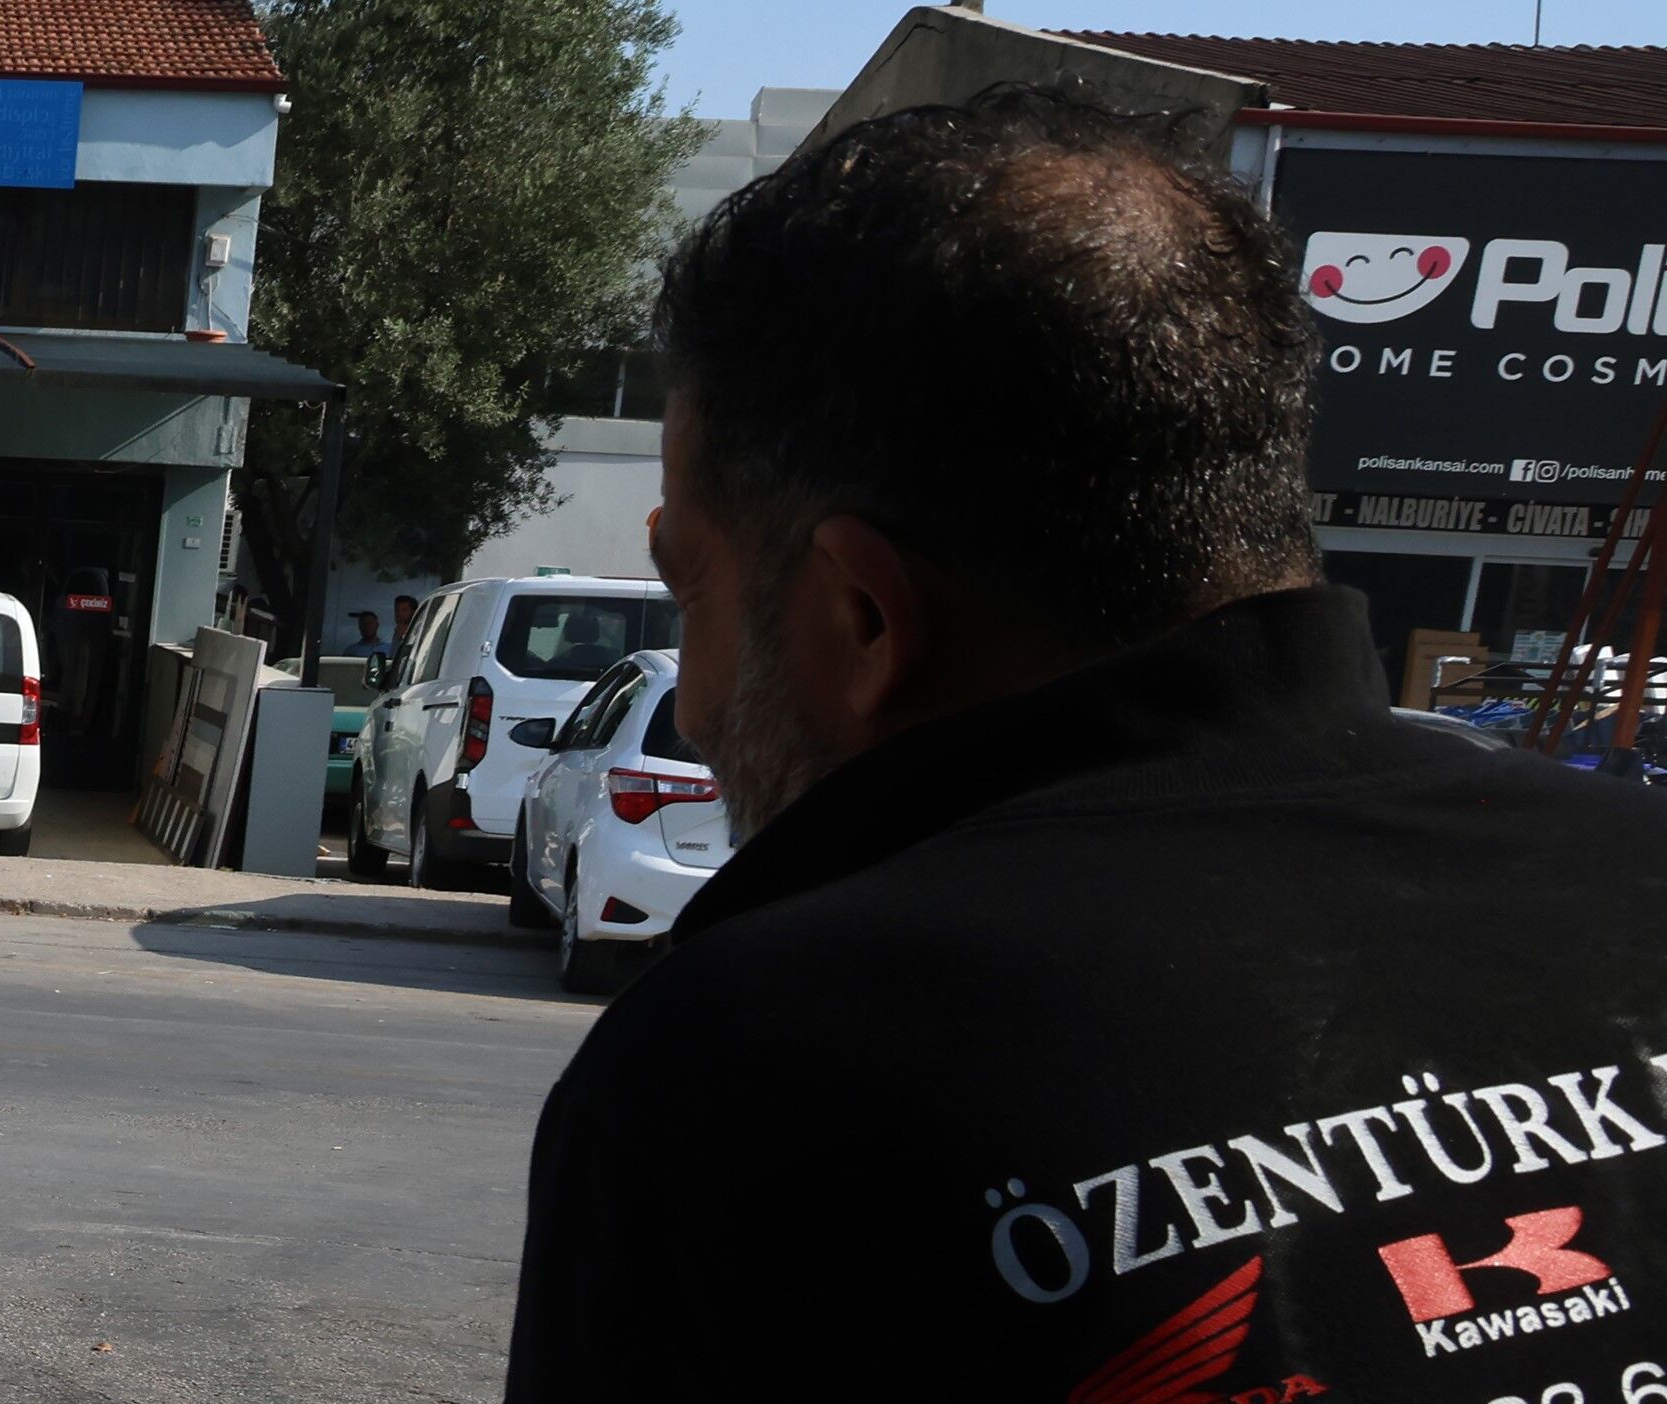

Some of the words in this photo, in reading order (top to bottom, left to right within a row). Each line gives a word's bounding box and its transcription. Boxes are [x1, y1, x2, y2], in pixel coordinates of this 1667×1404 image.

[1329, 345, 1459, 378] OME
[1357, 455, 1505, 474] polisankansai.com
[1560, 463, 1667, 481] /polisanhme
[1357, 495, 1487, 531] NALBURİYE
[1506, 500, 1590, 536] CİVATA
[984, 1065, 1667, 1304] ÖZENTÜRK
[1415, 1277, 1631, 1358] Kawasaki
